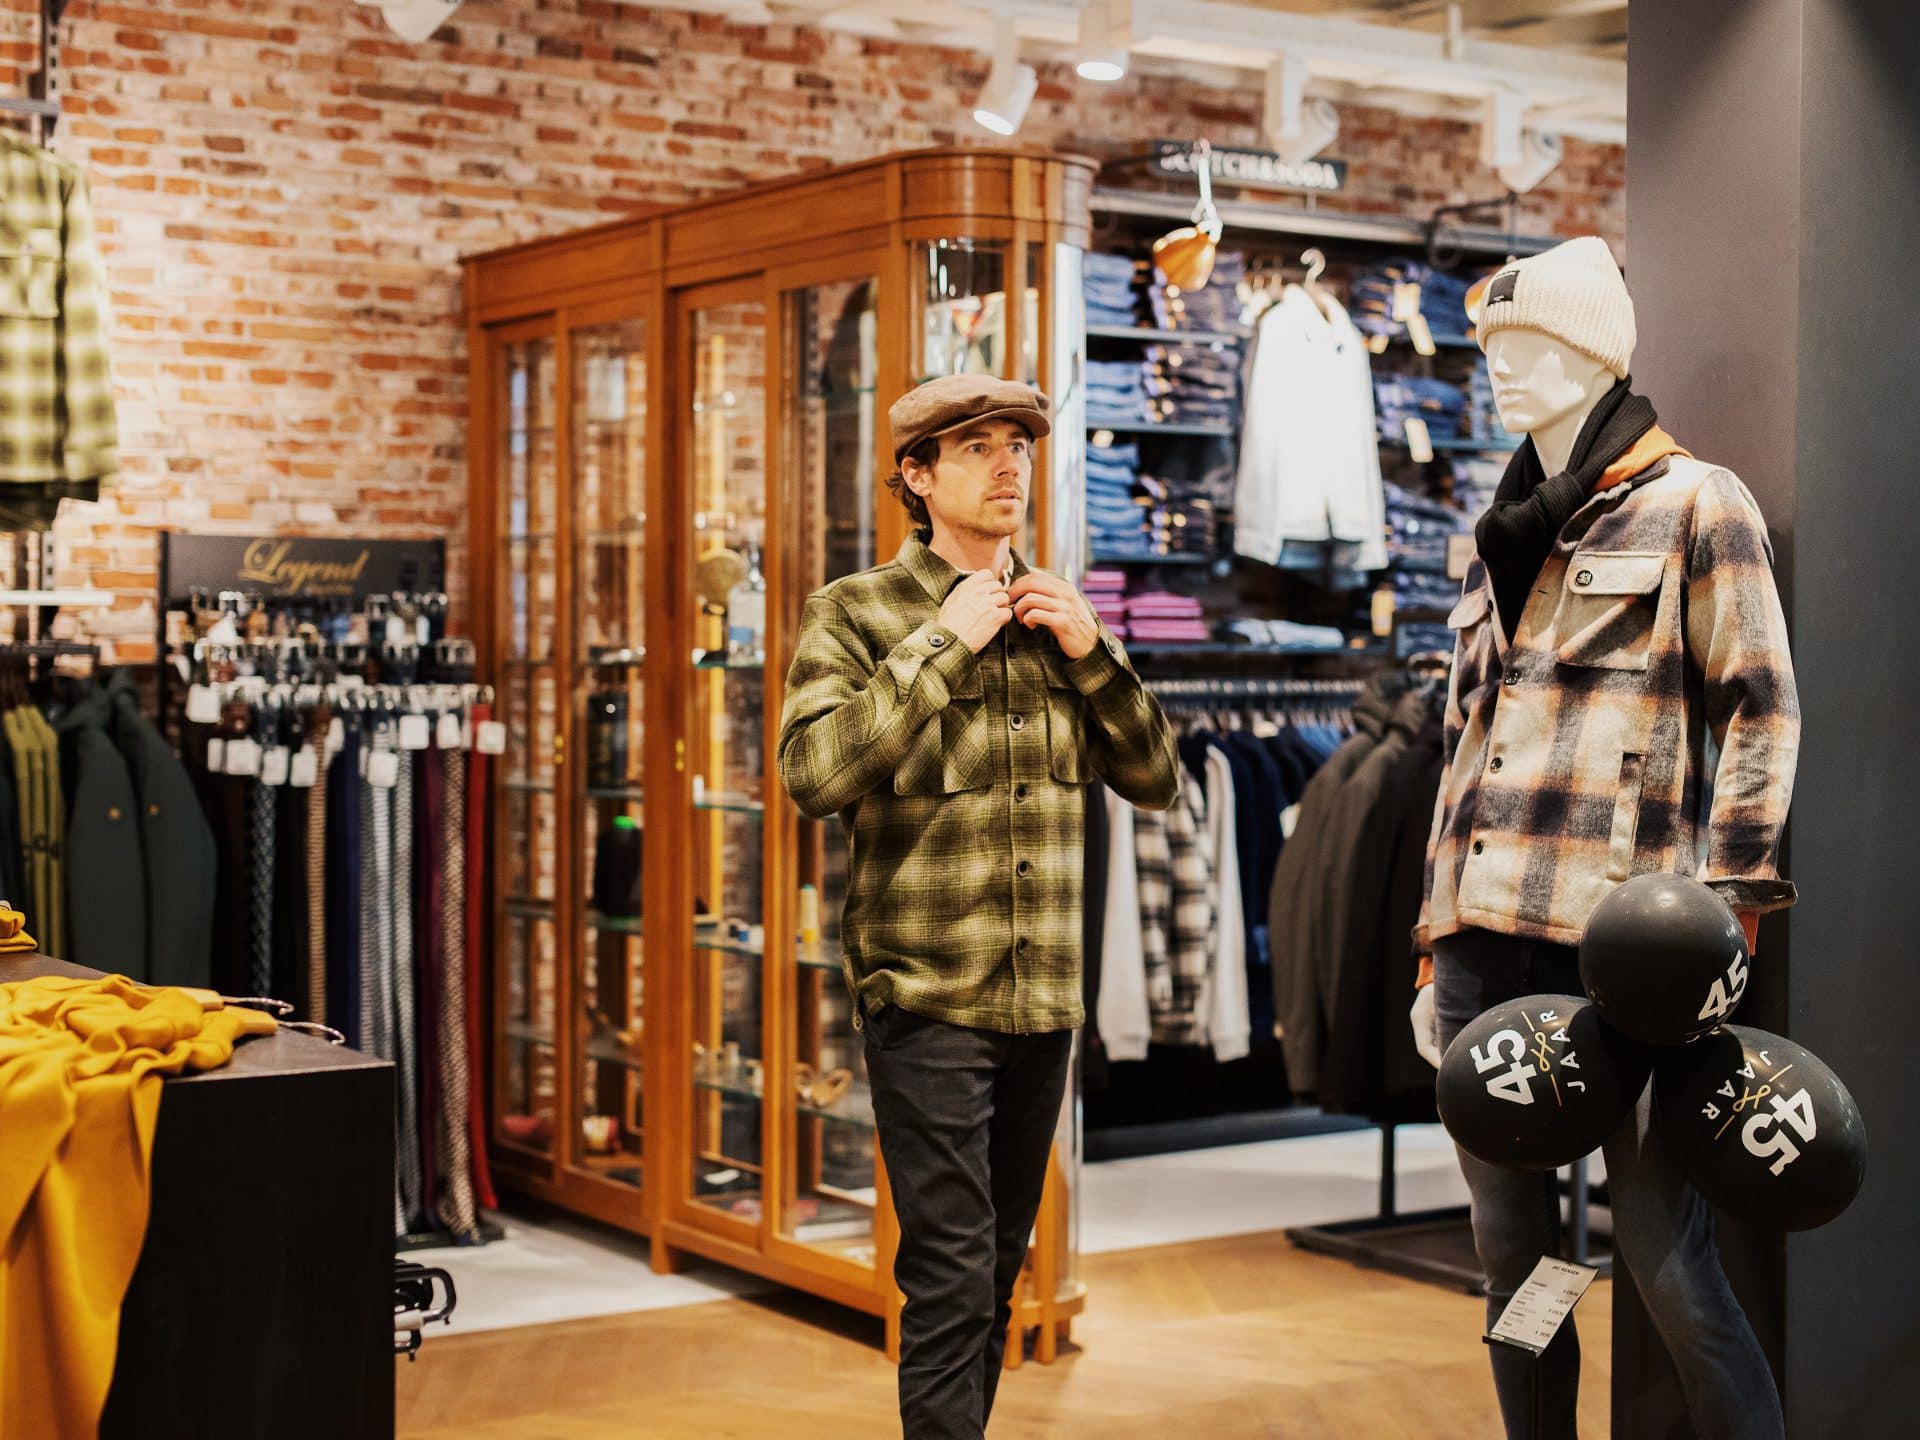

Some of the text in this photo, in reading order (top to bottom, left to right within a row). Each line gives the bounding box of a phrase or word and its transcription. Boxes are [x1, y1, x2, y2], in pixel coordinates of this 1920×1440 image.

[239, 537, 370, 594] Legend
[1697, 949, 1749, 1021] 45
[1469, 1028, 1537, 1105] 45
[1539, 1009, 1587, 1093] JAAR
[1702, 1050, 1774, 1120] JAAR
[1741, 1087, 1817, 1177] 45
